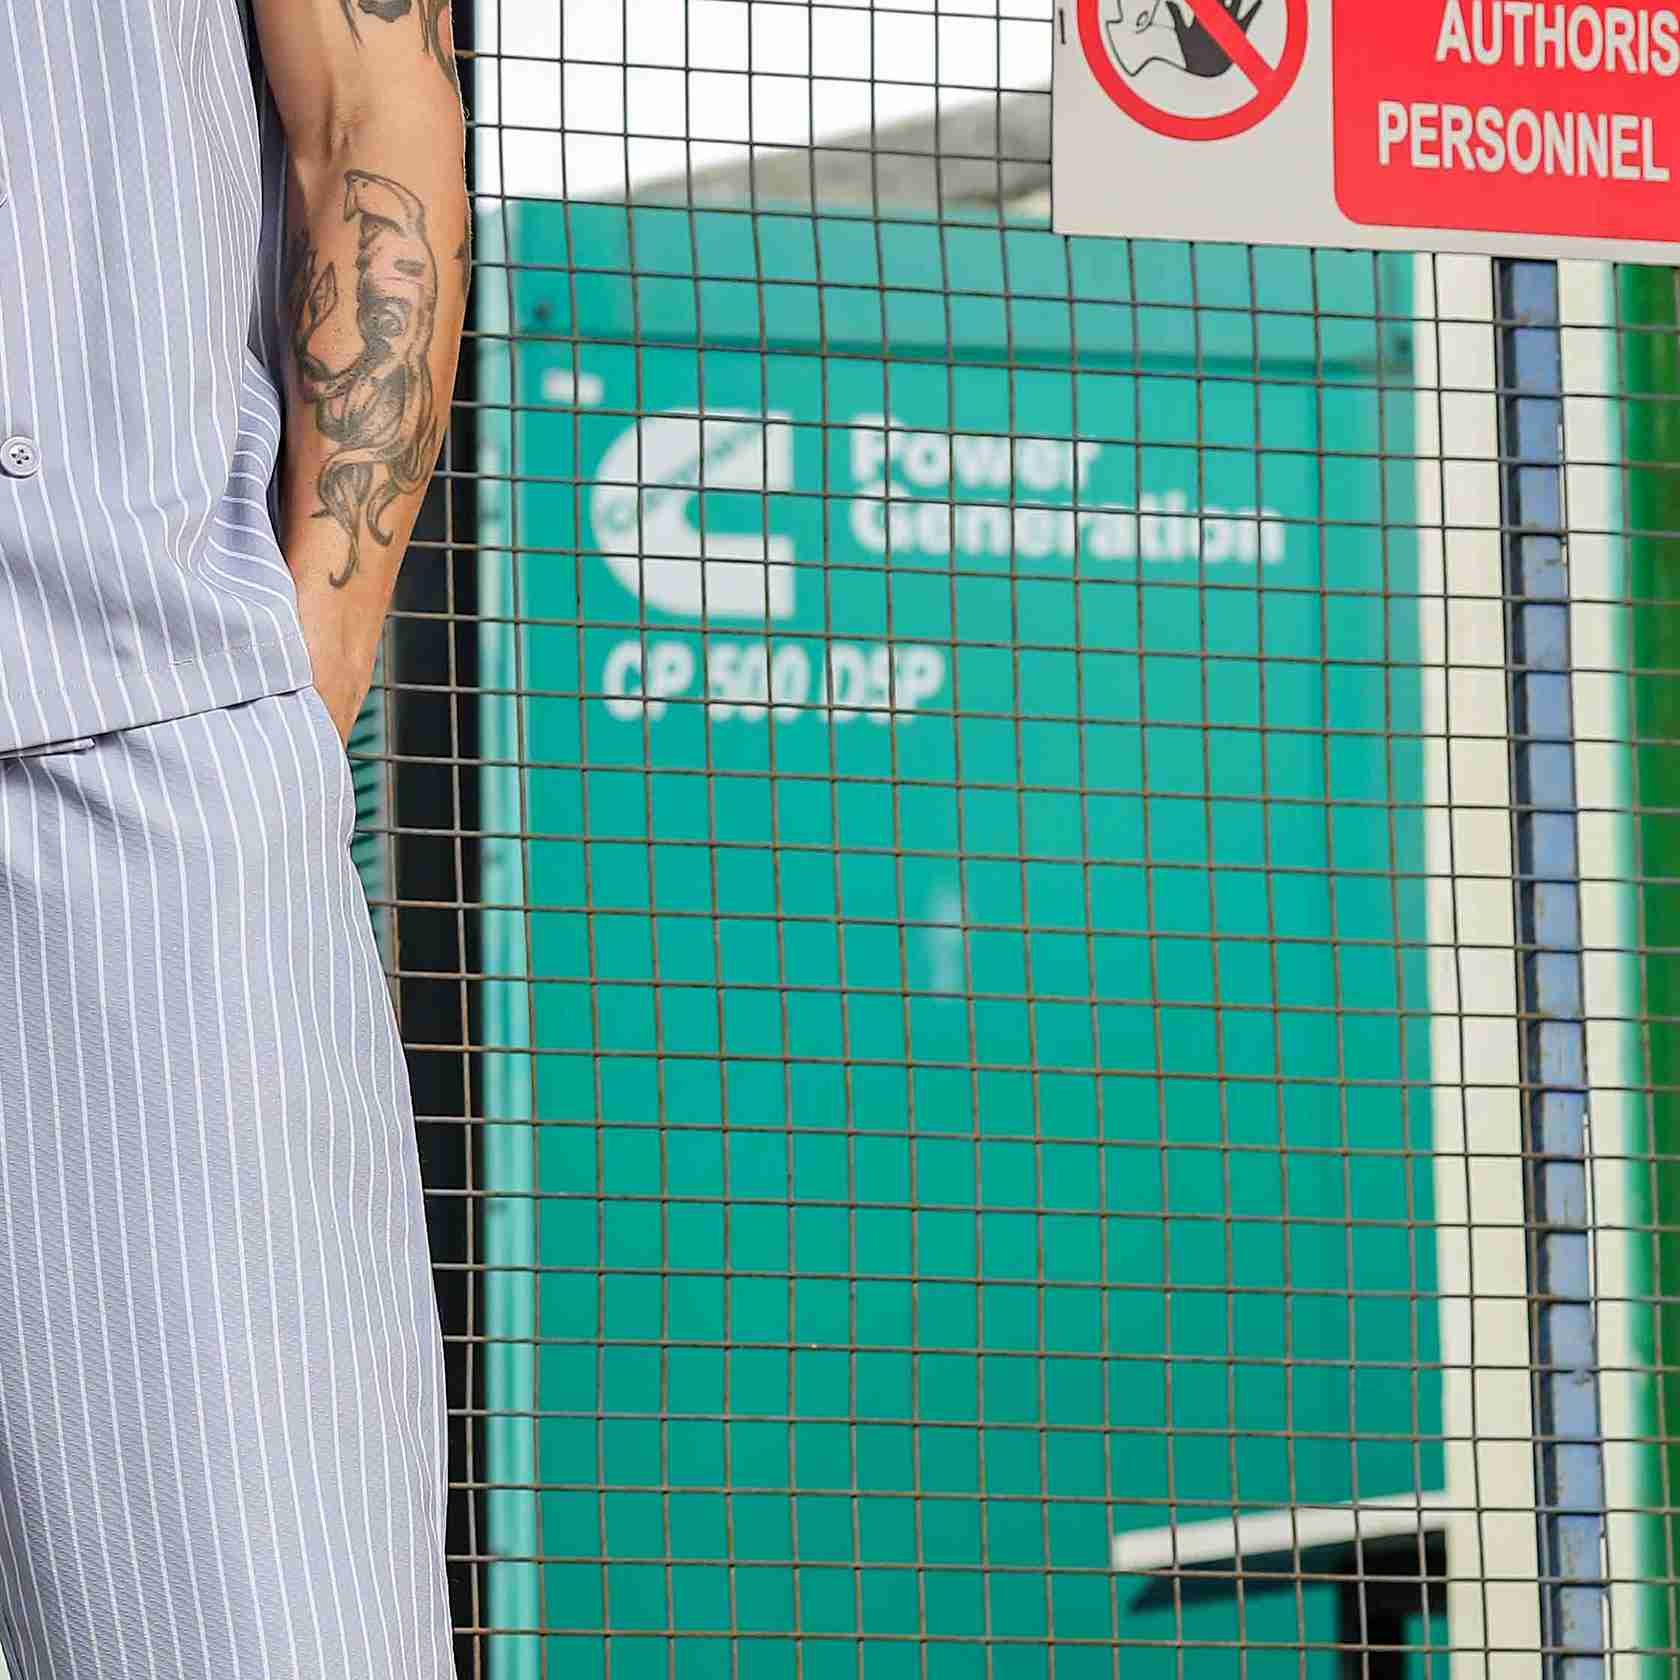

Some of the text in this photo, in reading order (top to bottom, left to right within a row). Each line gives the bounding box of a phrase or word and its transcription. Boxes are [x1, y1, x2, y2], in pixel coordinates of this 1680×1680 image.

[1378, 100, 1670, 182] PERSONNEL
[849, 413, 1102, 491] Power
[849, 480, 1286, 563] Generation
